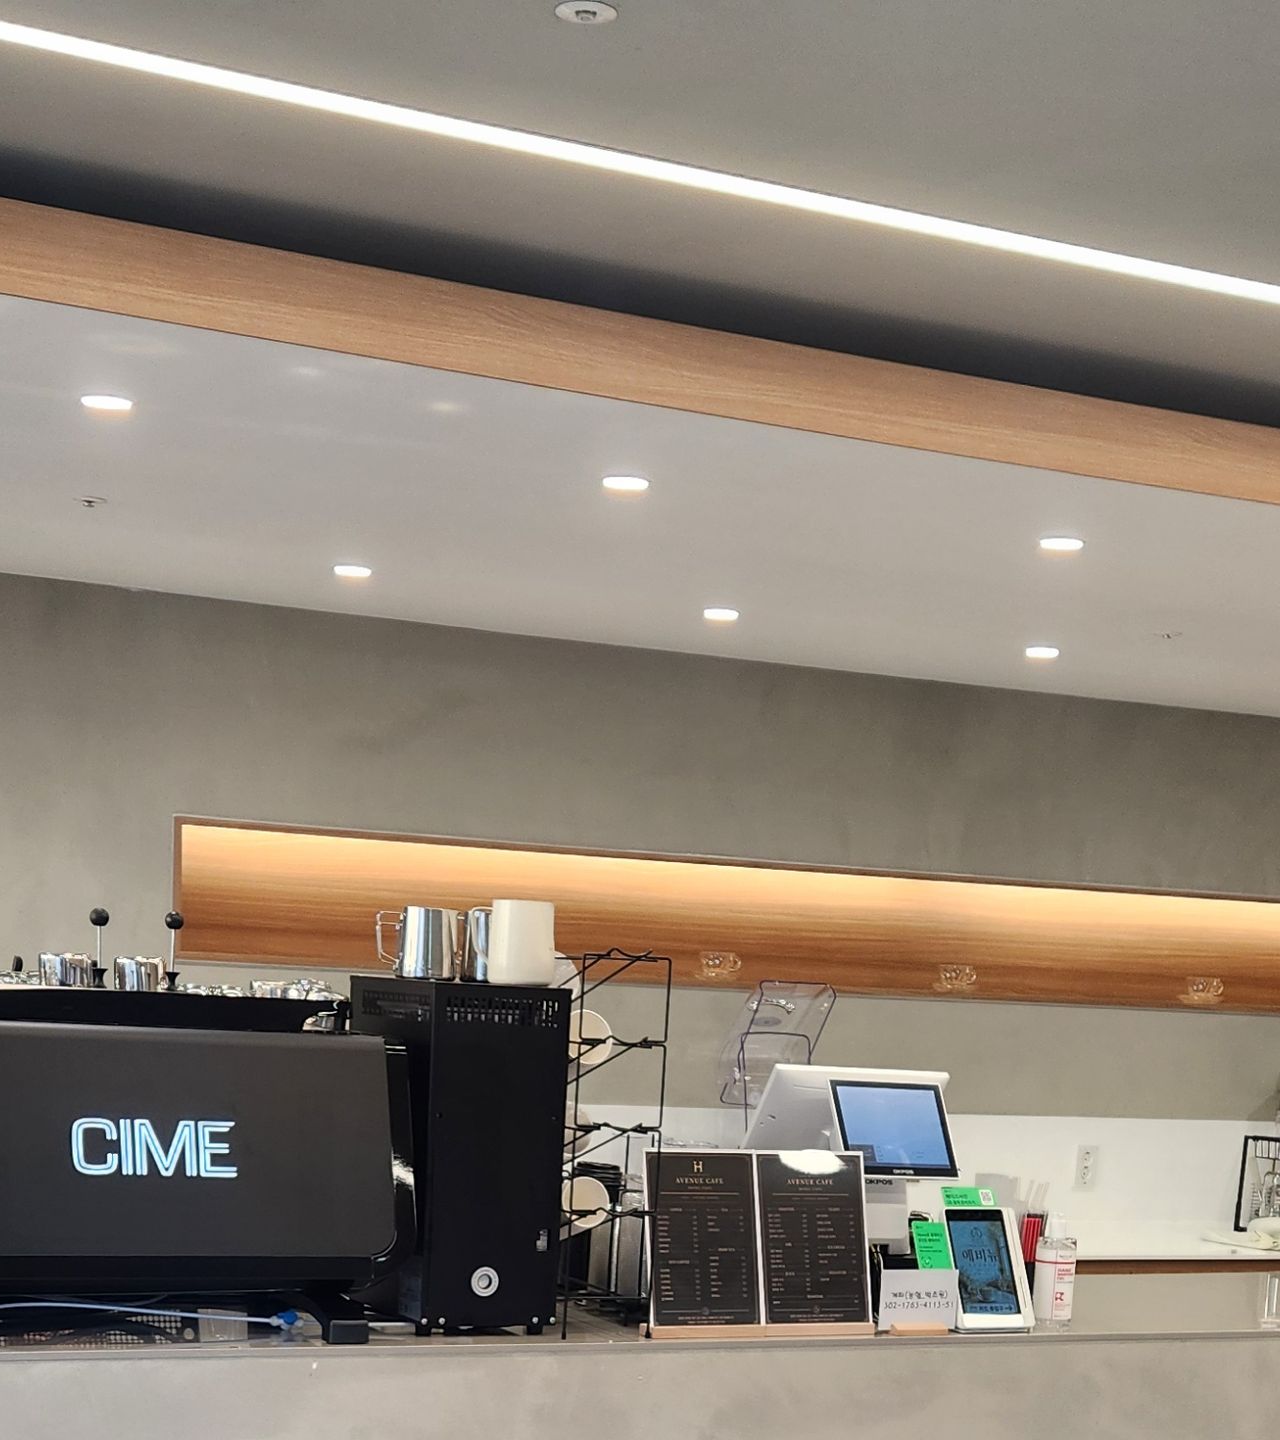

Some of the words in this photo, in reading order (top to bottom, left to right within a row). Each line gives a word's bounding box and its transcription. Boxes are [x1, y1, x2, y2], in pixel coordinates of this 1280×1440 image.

[71, 1117, 239, 1178] CIME
[675, 1176, 704, 1185] AVENUE
[787, 1178, 815, 1186] AVENUE
